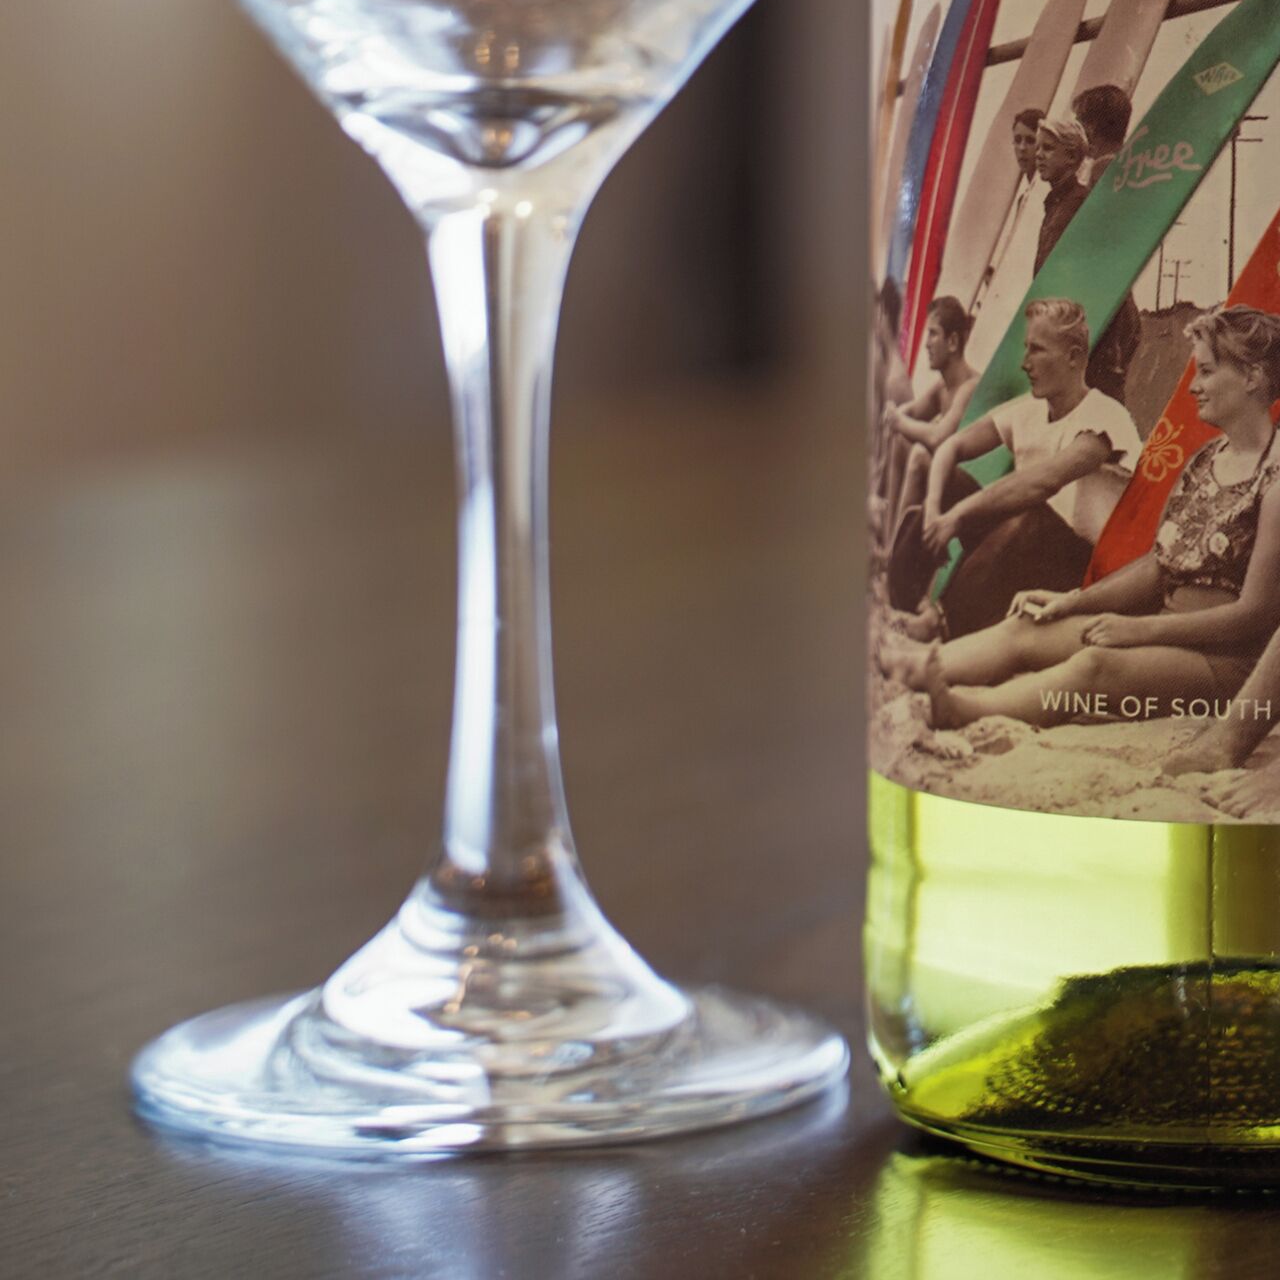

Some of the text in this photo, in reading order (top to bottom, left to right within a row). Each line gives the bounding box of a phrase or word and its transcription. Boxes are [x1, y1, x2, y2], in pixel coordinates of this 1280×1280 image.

[1039, 689, 1109, 717] WINE
[1120, 695, 1159, 718] OF
[1170, 697, 1272, 721] SOUTH
